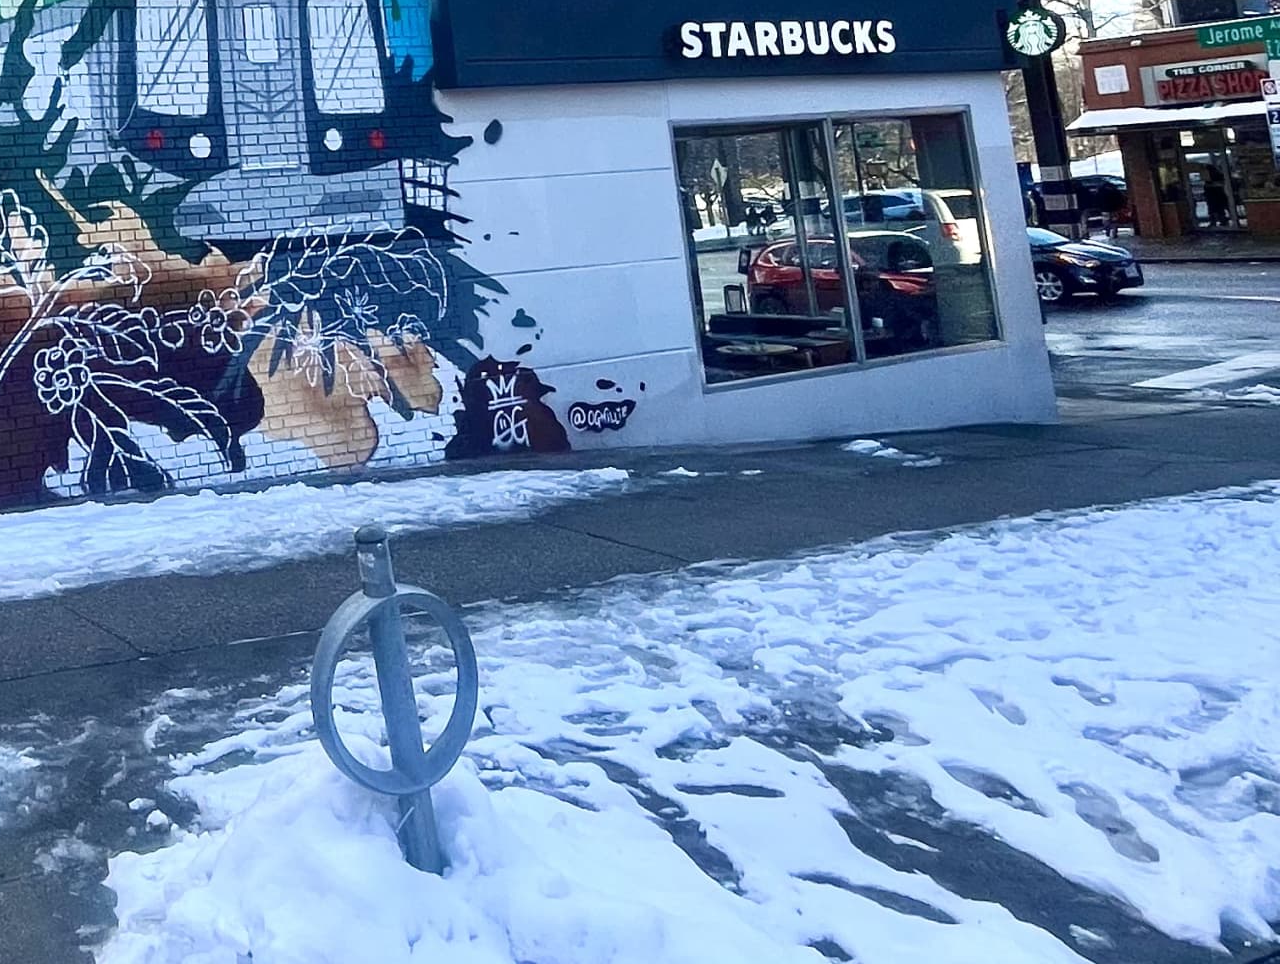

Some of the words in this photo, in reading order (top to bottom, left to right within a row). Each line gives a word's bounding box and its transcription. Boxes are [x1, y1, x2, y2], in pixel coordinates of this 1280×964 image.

[680, 20, 896, 59] STARBUCKS
[1205, 25, 1264, 45] Jerome
[1172, 67, 1194, 76] THE
[1198, 62, 1245, 74] CORNER
[1157, 76, 1213, 100] PIZZA
